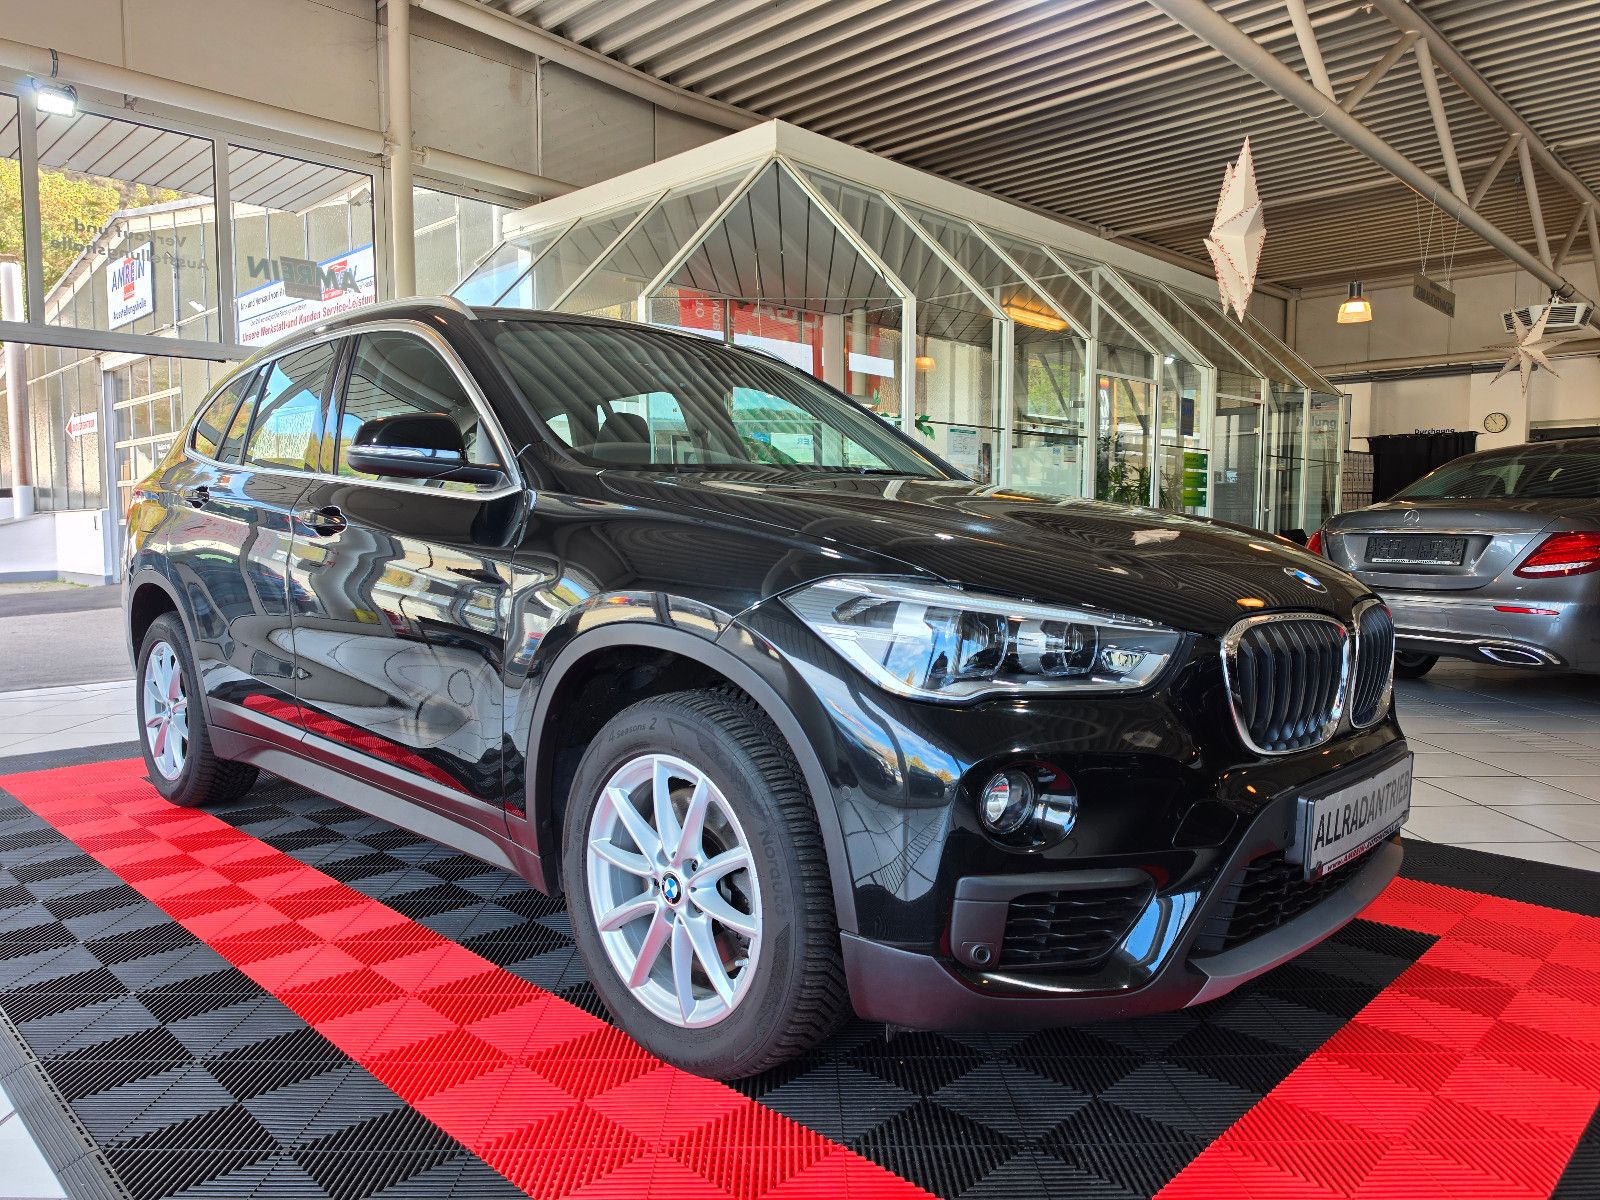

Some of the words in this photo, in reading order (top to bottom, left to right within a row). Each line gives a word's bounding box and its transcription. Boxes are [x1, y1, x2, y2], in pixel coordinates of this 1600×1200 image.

[111, 257, 145, 292] AMREIN
[243, 331, 260, 342] Unsere
[649, 717, 658, 730] 2
[1313, 770, 1410, 852] ALLRADANTRIEB
